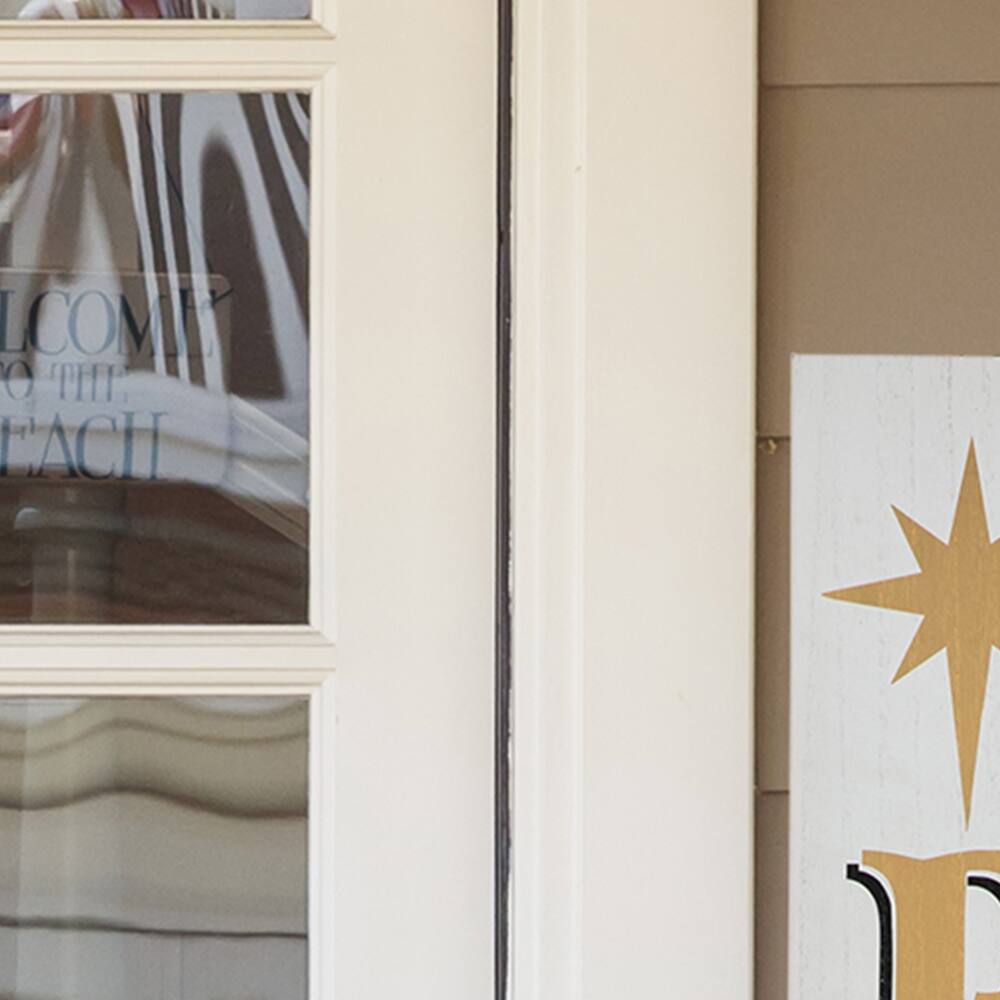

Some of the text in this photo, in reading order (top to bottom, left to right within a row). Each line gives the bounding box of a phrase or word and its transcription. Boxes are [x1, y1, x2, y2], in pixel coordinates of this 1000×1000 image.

[0, 360, 130, 403] O THE
[0, 411, 168, 481] EACH
